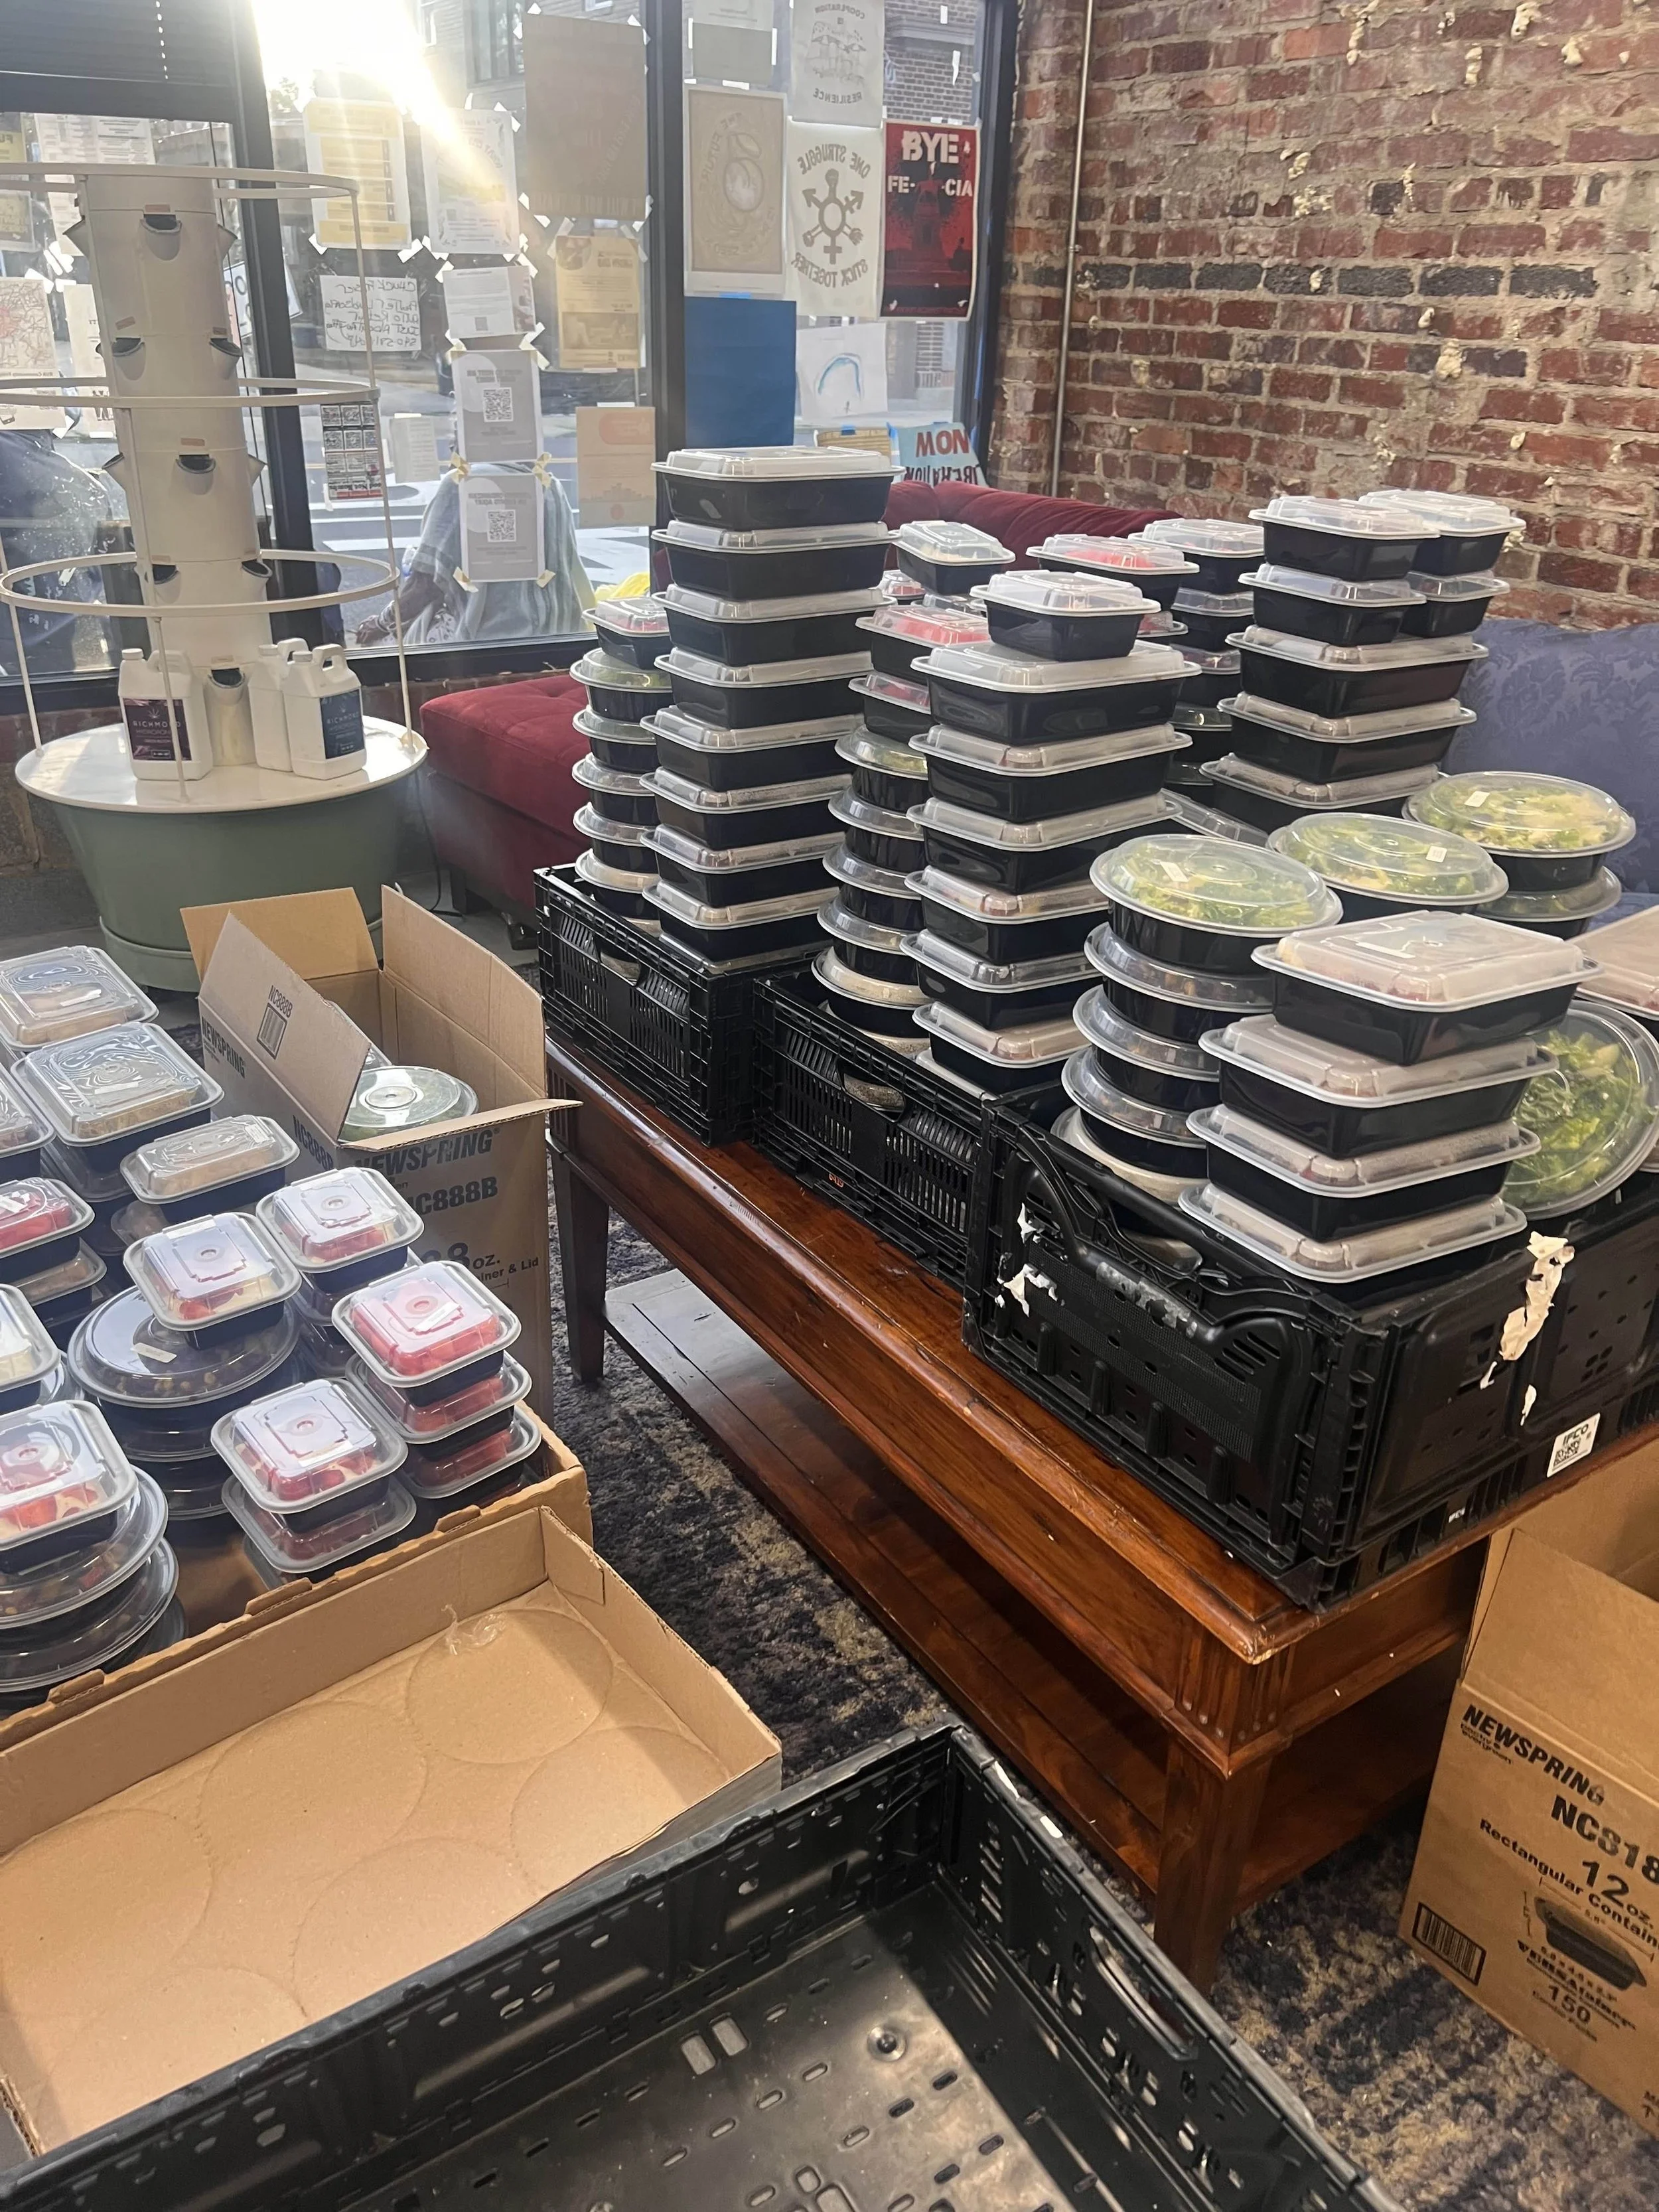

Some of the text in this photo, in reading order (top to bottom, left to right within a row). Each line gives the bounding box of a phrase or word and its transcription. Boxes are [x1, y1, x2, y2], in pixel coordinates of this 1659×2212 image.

[902, 129, 960, 165] BYE
[915, 429, 970, 458] NOW
[268, 985, 293, 1018] NC888B
[201, 1016, 245, 1079] NEWSPRING
[508, 1264, 517, 1274] &
[521, 1257, 539, 1270] Lid
[1563, 1423, 1589, 1446] IFCO
[1462, 1704, 1605, 1806] NEWSPRING
[1480, 1818, 1659, 1951] Rectangular Contain
[1548, 1985, 1591, 2024] 150
